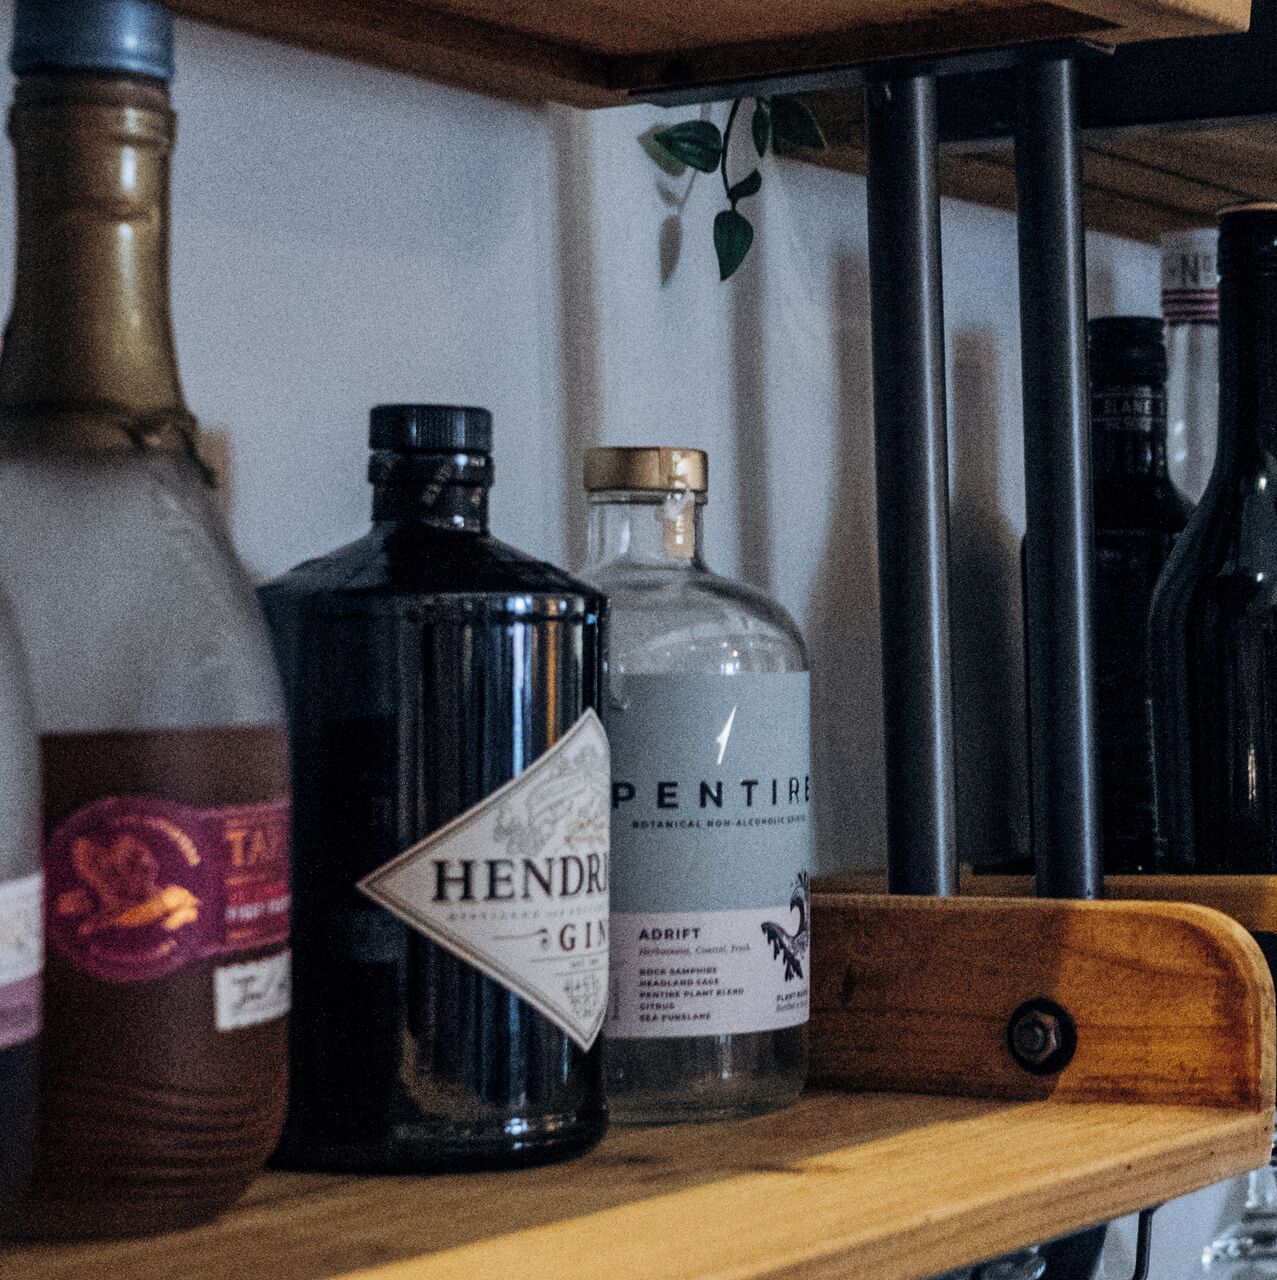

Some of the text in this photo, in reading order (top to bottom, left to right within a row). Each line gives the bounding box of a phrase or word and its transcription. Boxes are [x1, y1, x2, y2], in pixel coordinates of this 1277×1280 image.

[631, 820, 700, 830] BOTANICAL
[638, 927, 702, 941] ADRIFT
[638, 966, 718, 977] ROCK SAMPHIRE
[638, 978, 694, 989] HEADLAND
[683, 989, 714, 999] PLANT
[638, 1001, 675, 1011] CITRUS
